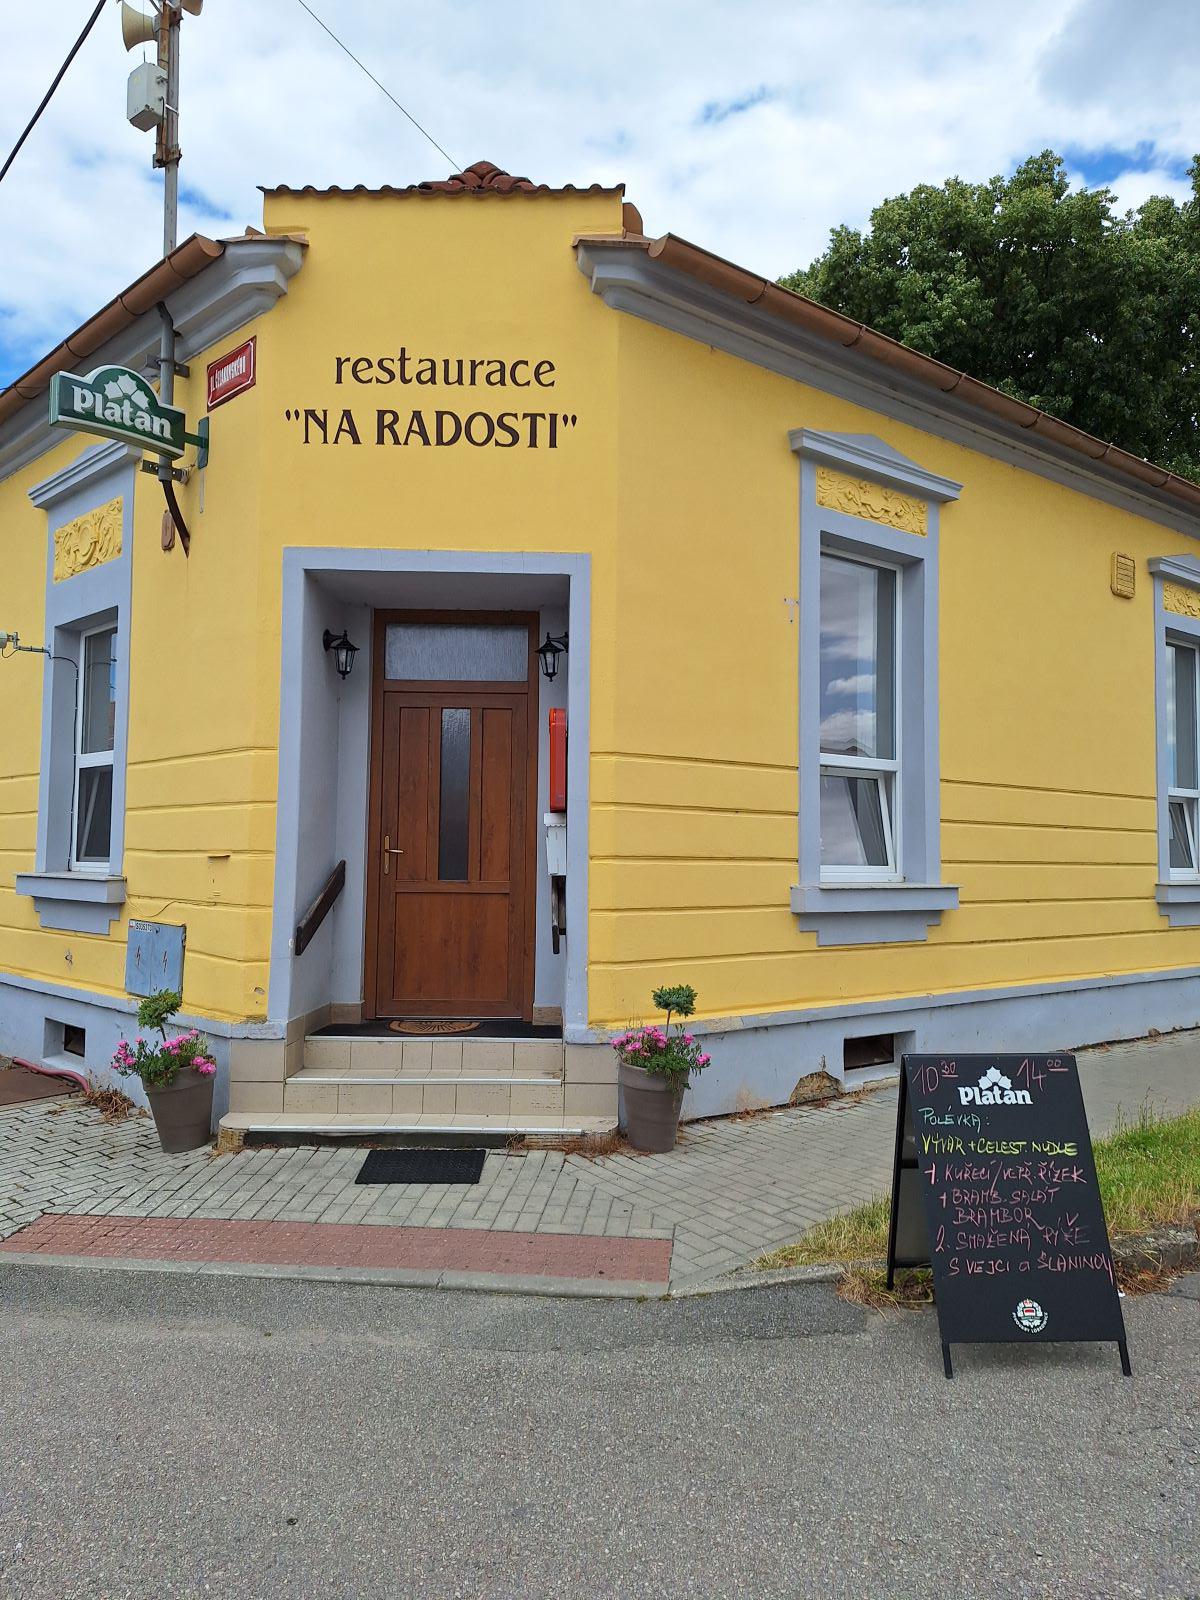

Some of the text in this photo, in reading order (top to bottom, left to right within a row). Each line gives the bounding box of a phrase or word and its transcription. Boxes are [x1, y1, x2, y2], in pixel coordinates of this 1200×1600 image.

[334, 347, 556, 387] restaurace
[1032, 1141, 1079, 1156] NUDLE
[1009, 1186, 1061, 1204] SALÁT
[966, 1258, 1010, 1275] VEJCI
